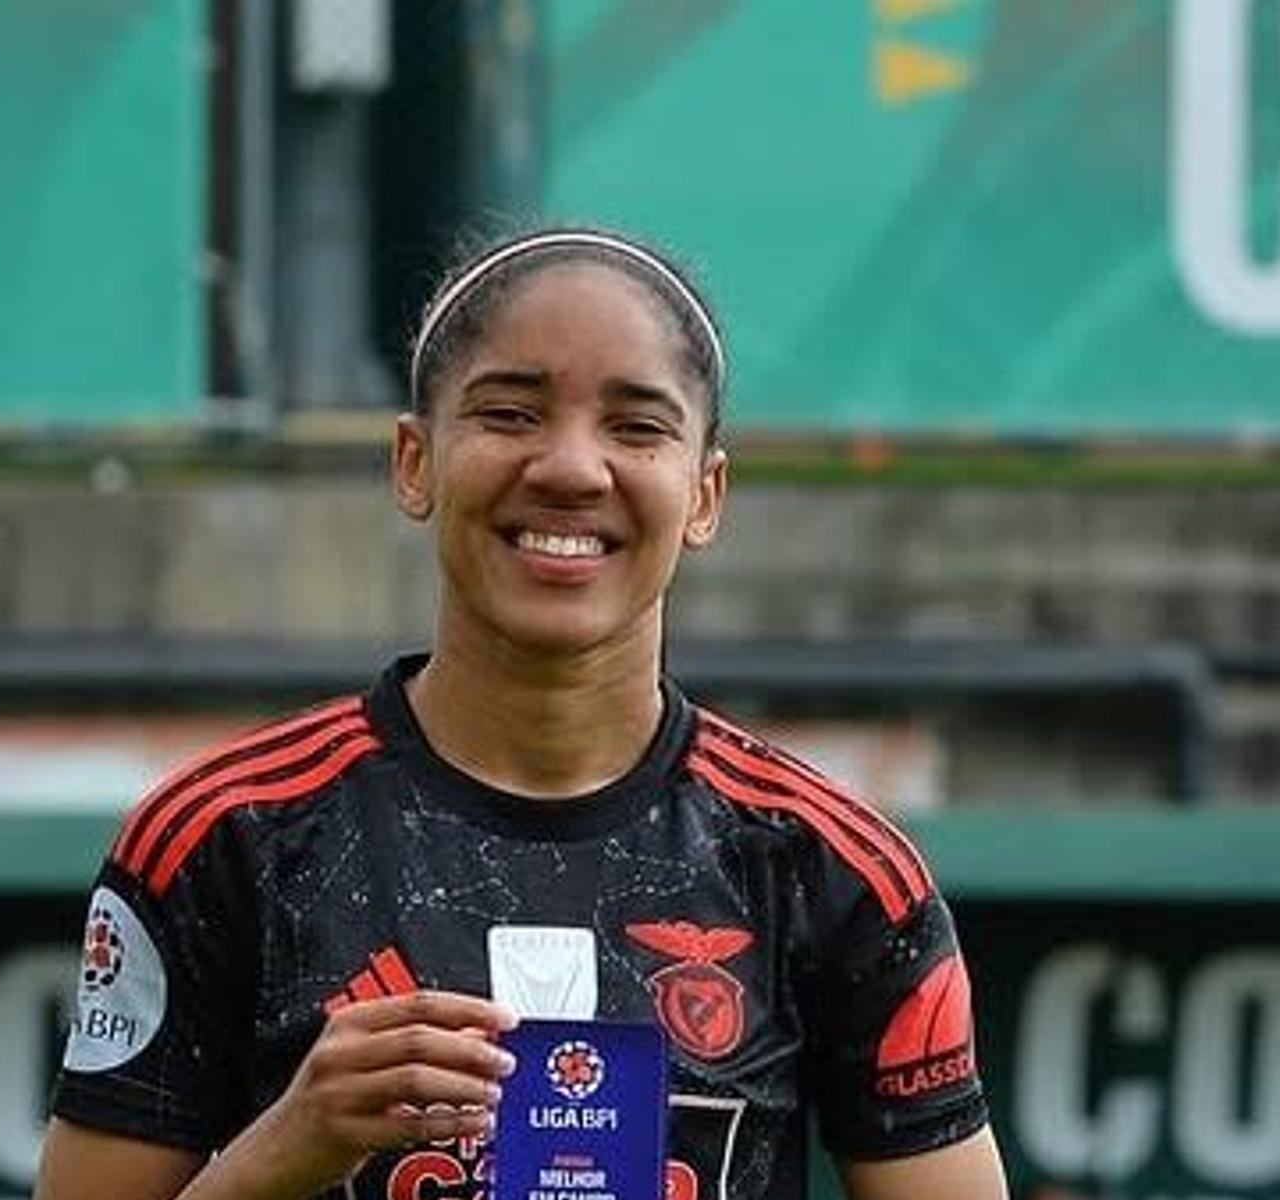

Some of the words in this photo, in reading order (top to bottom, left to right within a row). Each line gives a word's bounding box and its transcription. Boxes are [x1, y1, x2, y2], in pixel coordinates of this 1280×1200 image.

[528, 1105, 581, 1129] LIGA
[581, 1107, 617, 1131] BPI
[540, 1168, 606, 1189] MELHOR
